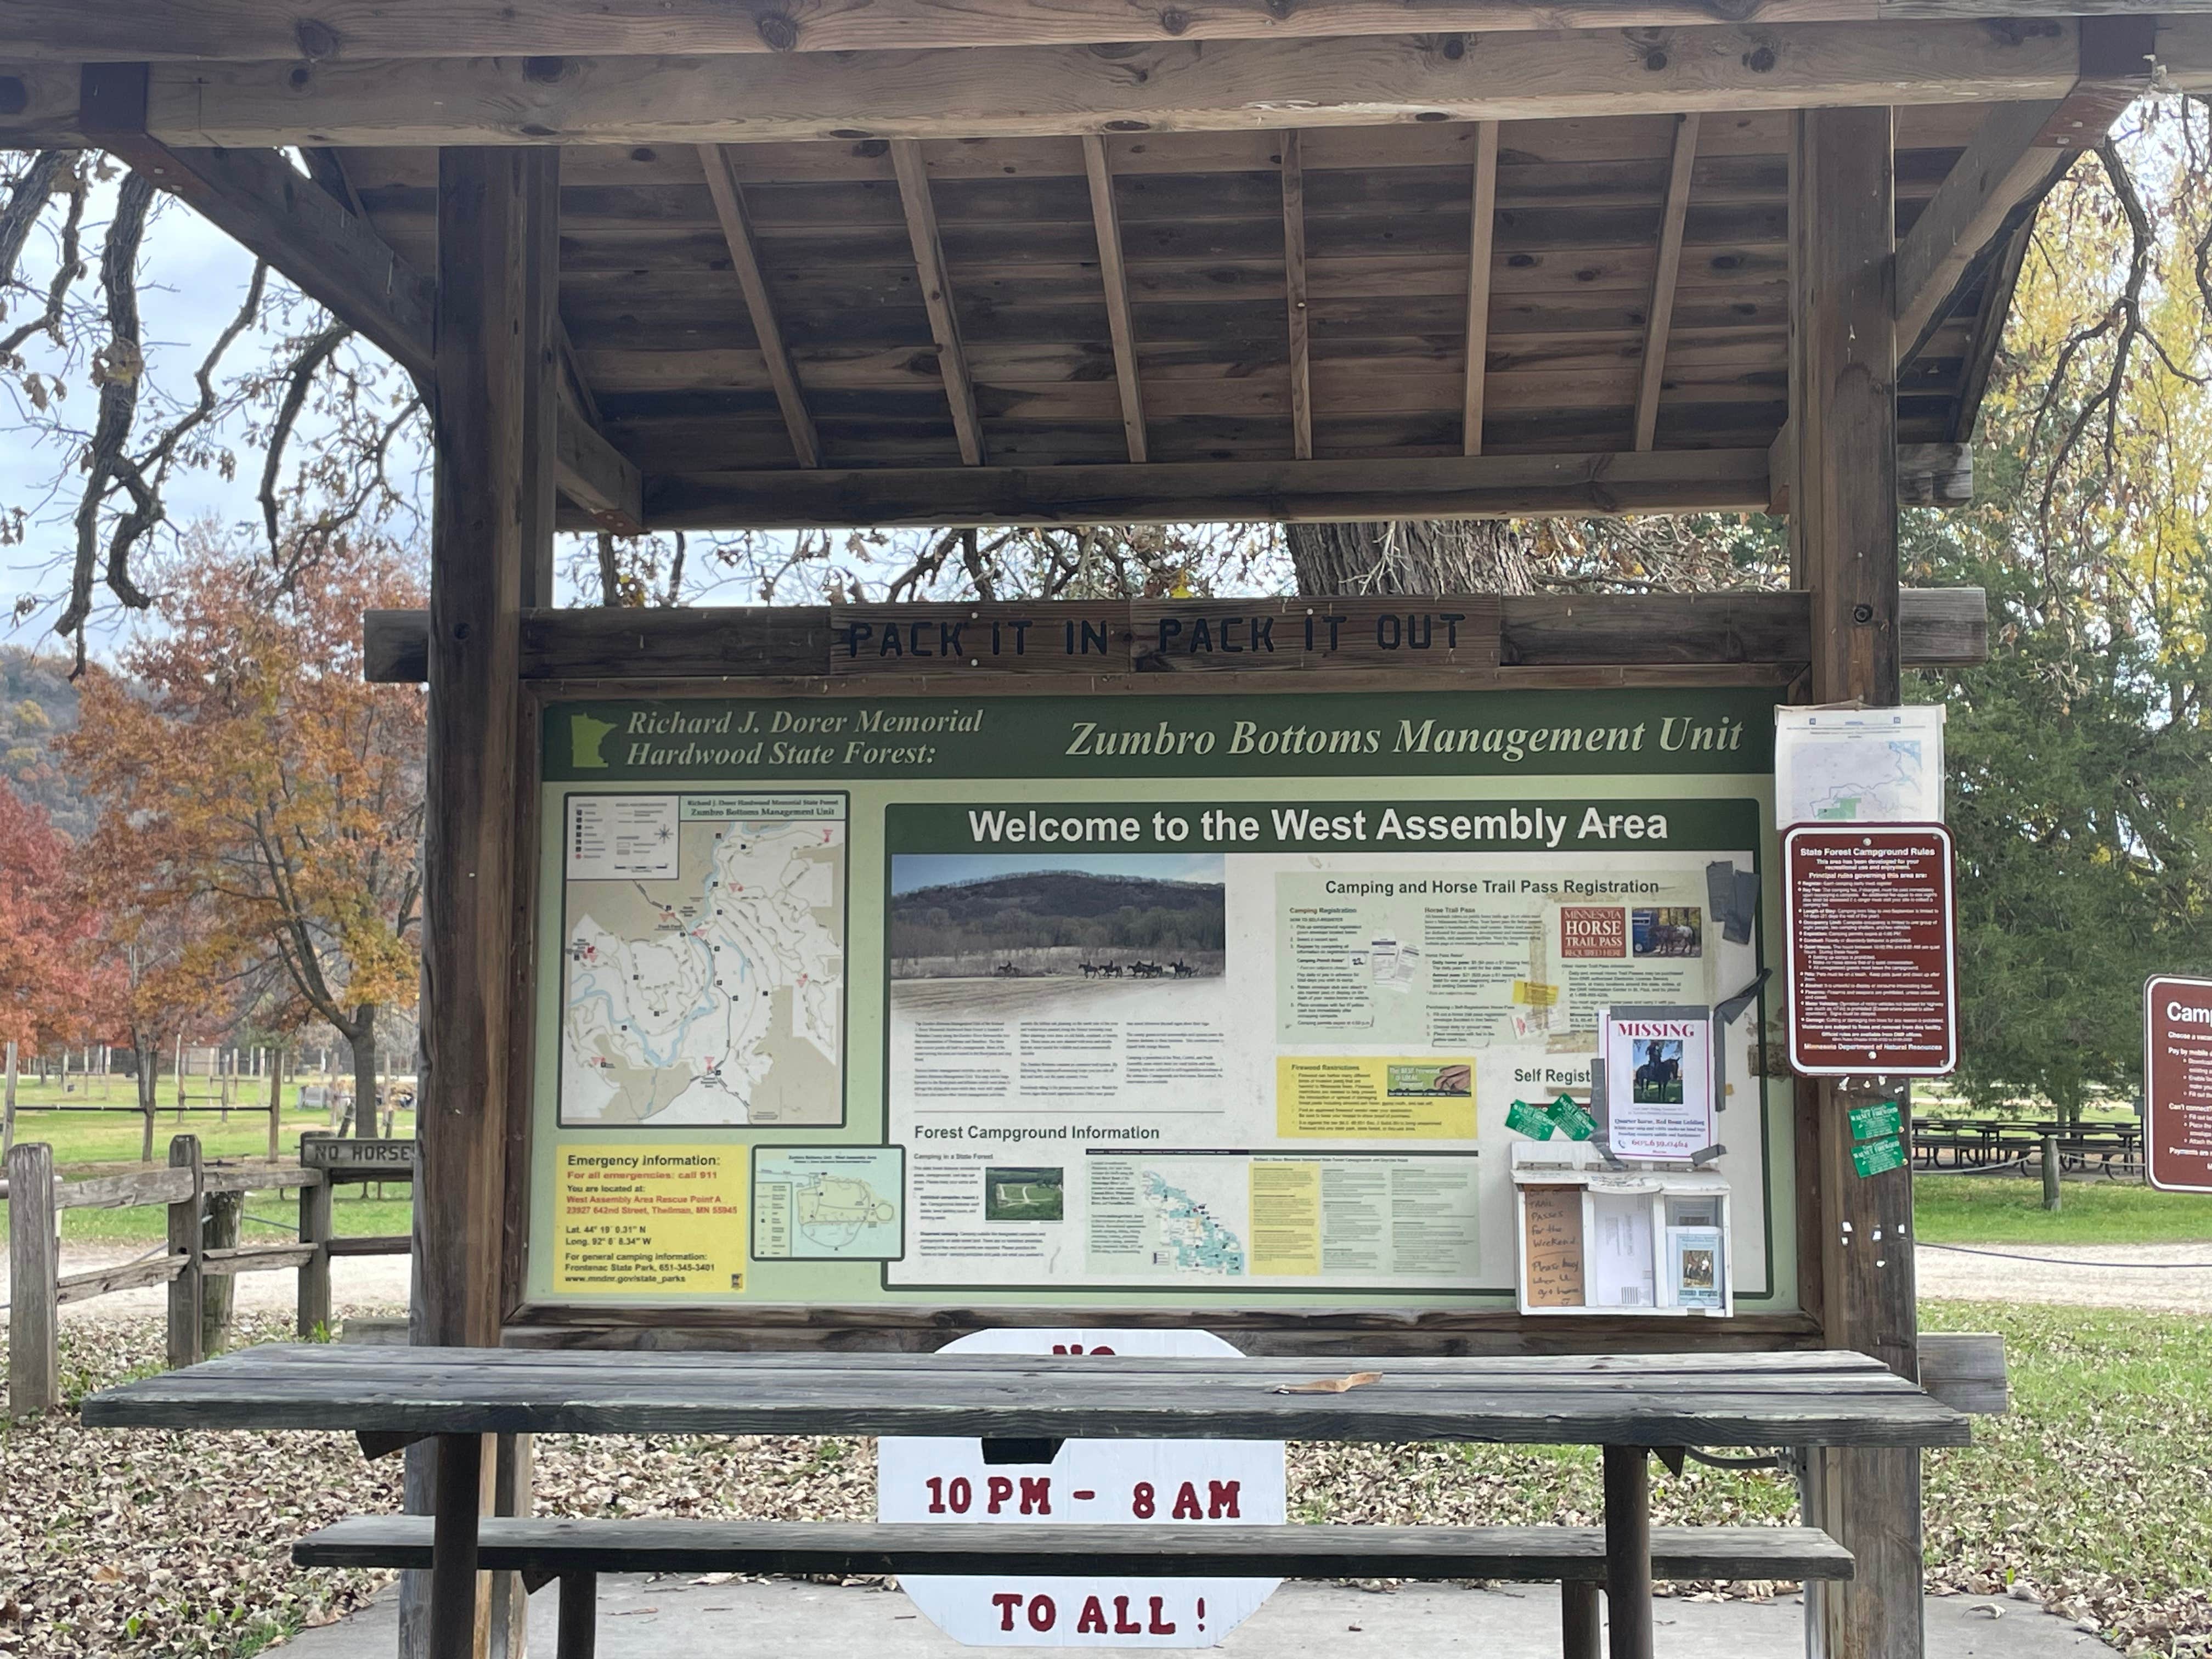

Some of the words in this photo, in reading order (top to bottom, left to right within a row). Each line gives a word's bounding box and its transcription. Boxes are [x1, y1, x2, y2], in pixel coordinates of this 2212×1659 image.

[849, 622, 963, 657] PACK
[992, 620, 1032, 656] IT
[1065, 619, 1107, 655] IN
[1159, 617, 1275, 653] PACK
[1305, 615, 1347, 651] IT
[1376, 613, 1465, 650] OUT
[627, 711, 733, 734] Richard
[738, 712, 761, 734] J.
[770, 710, 848, 733] Dorer
[854, 709, 985, 733] Memorial
[1065, 722, 1216, 755] Zumbro
[1227, 721, 1381, 754] Bottoms
[1392, 719, 1646, 762] Management
[1660, 716, 1743, 752] Unit
[626, 742, 763, 765] Hardwood
[769, 742, 834, 765] State
[843, 741, 936, 764] Forest:
[761, 808, 814, 817] Management
[968, 810, 1141, 842] Welcome
[1152, 811, 1189, 842] to
[1201, 809, 1260, 842] the
[1271, 808, 1367, 840] West
[1376, 807, 1567, 848] Assembly
[1577, 807, 1668, 840] Area
[1853, 848, 1908, 857] Campground
[1326, 881, 1394, 896] Camping
[1399, 881, 1426, 893] and
[1432, 881, 1477, 893] Horse
[1483, 880, 1516, 893] Trail
[1521, 880, 1558, 893] Pass
[1564, 879, 1659, 895] Registration
[1565, 910, 1622, 919] MINNESOTA
[1566, 920, 1622, 935] HORSE
[1566, 937, 1597, 946] TRAIL
[1599, 936, 1622, 946] PASS
[2167, 1001, 2212, 1028] Cam
[1618, 1023, 1694, 1037] MISSING
[2168, 1047, 2180, 1056] Pay
[2180, 1048, 2188, 1057] by
[1515, 1069, 1541, 1082] Self
[1546, 1069, 1590, 1085] Regist
[915, 1126, 963, 1139] Forest
[968, 1126, 1066, 1142] Campground
[1072, 1125, 1160, 1139] Information
[315, 1146, 338, 1160] NO
[352, 1145, 415, 1161] HORSE
[568, 1155, 639, 1169] Emergency
[603, 1172, 675, 1180] emergencies:
[590, 1196, 631, 1204] Assembly
[622, 1207, 649, 1215] Street,
[566, 1238, 590, 1246] Long.
[582, 1253, 614, 1262] general
[616, 1253, 653, 1262] camping
[926, 1476, 972, 1514] 10
[988, 1476, 1051, 1515] PM
[1133, 1481, 1155, 1519] 8
[1172, 1480, 1240, 1519] AM
[992, 1593, 1057, 1632] TO
[1076, 1595, 1176, 1635] ALL
[1196, 1597, 1206, 1632] !
